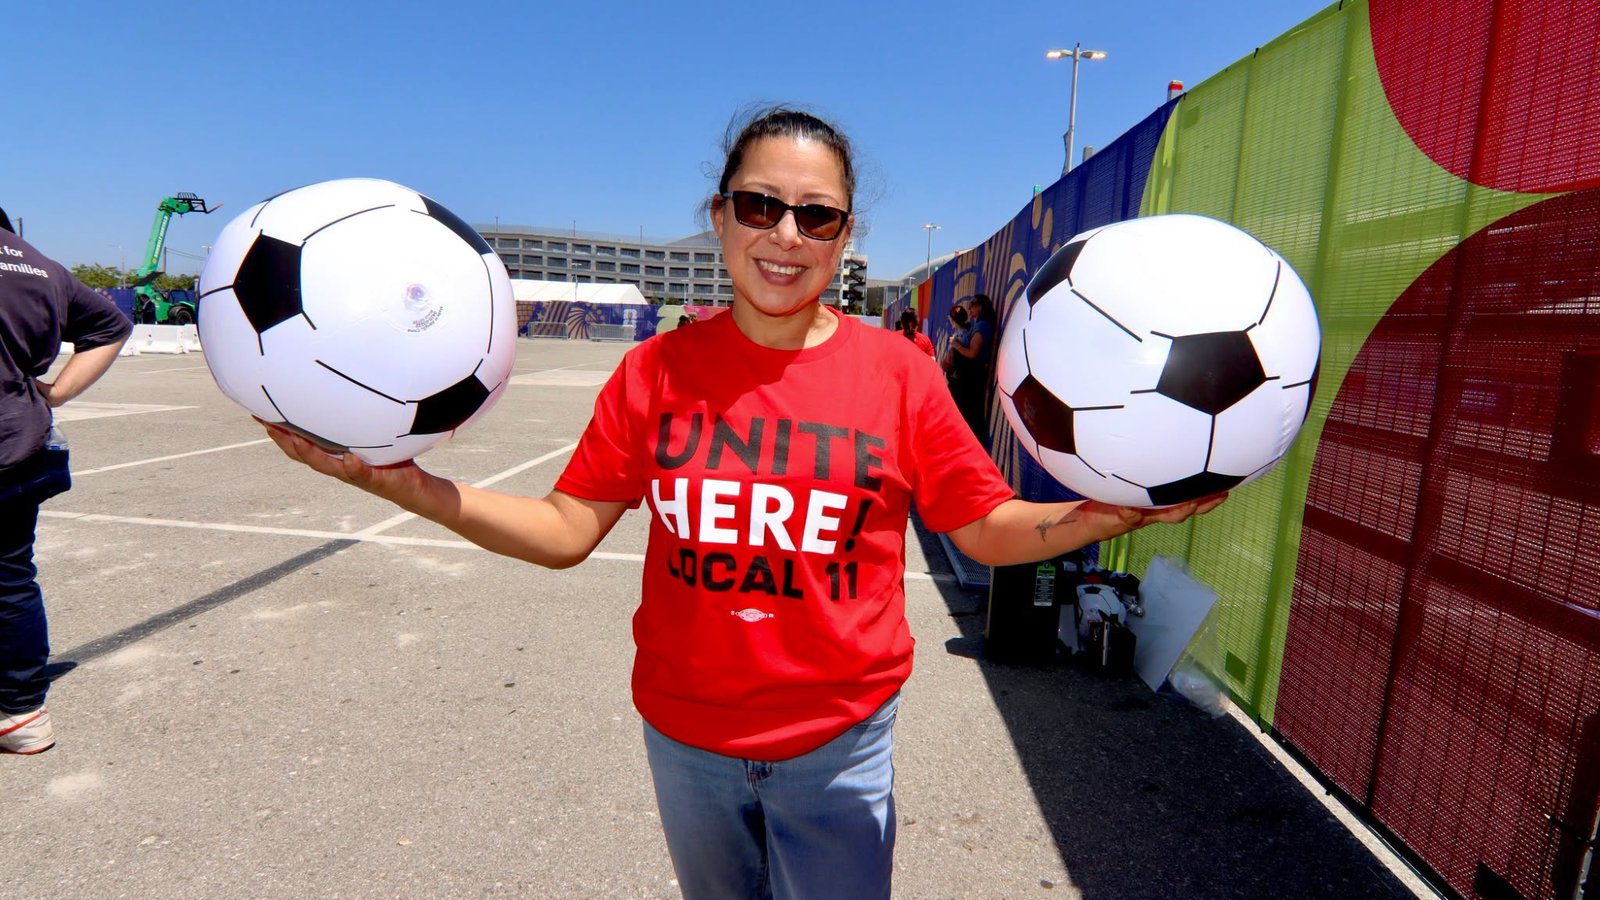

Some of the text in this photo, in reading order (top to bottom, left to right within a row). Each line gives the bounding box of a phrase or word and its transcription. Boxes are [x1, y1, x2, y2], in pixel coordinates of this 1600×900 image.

[0, 262, 49, 278] amilies
[3, 245, 24, 258] for
[654, 412, 887, 492] UNITE
[651, 477, 874, 555] HERE!
[667, 547, 859, 602] LOCAL 11
